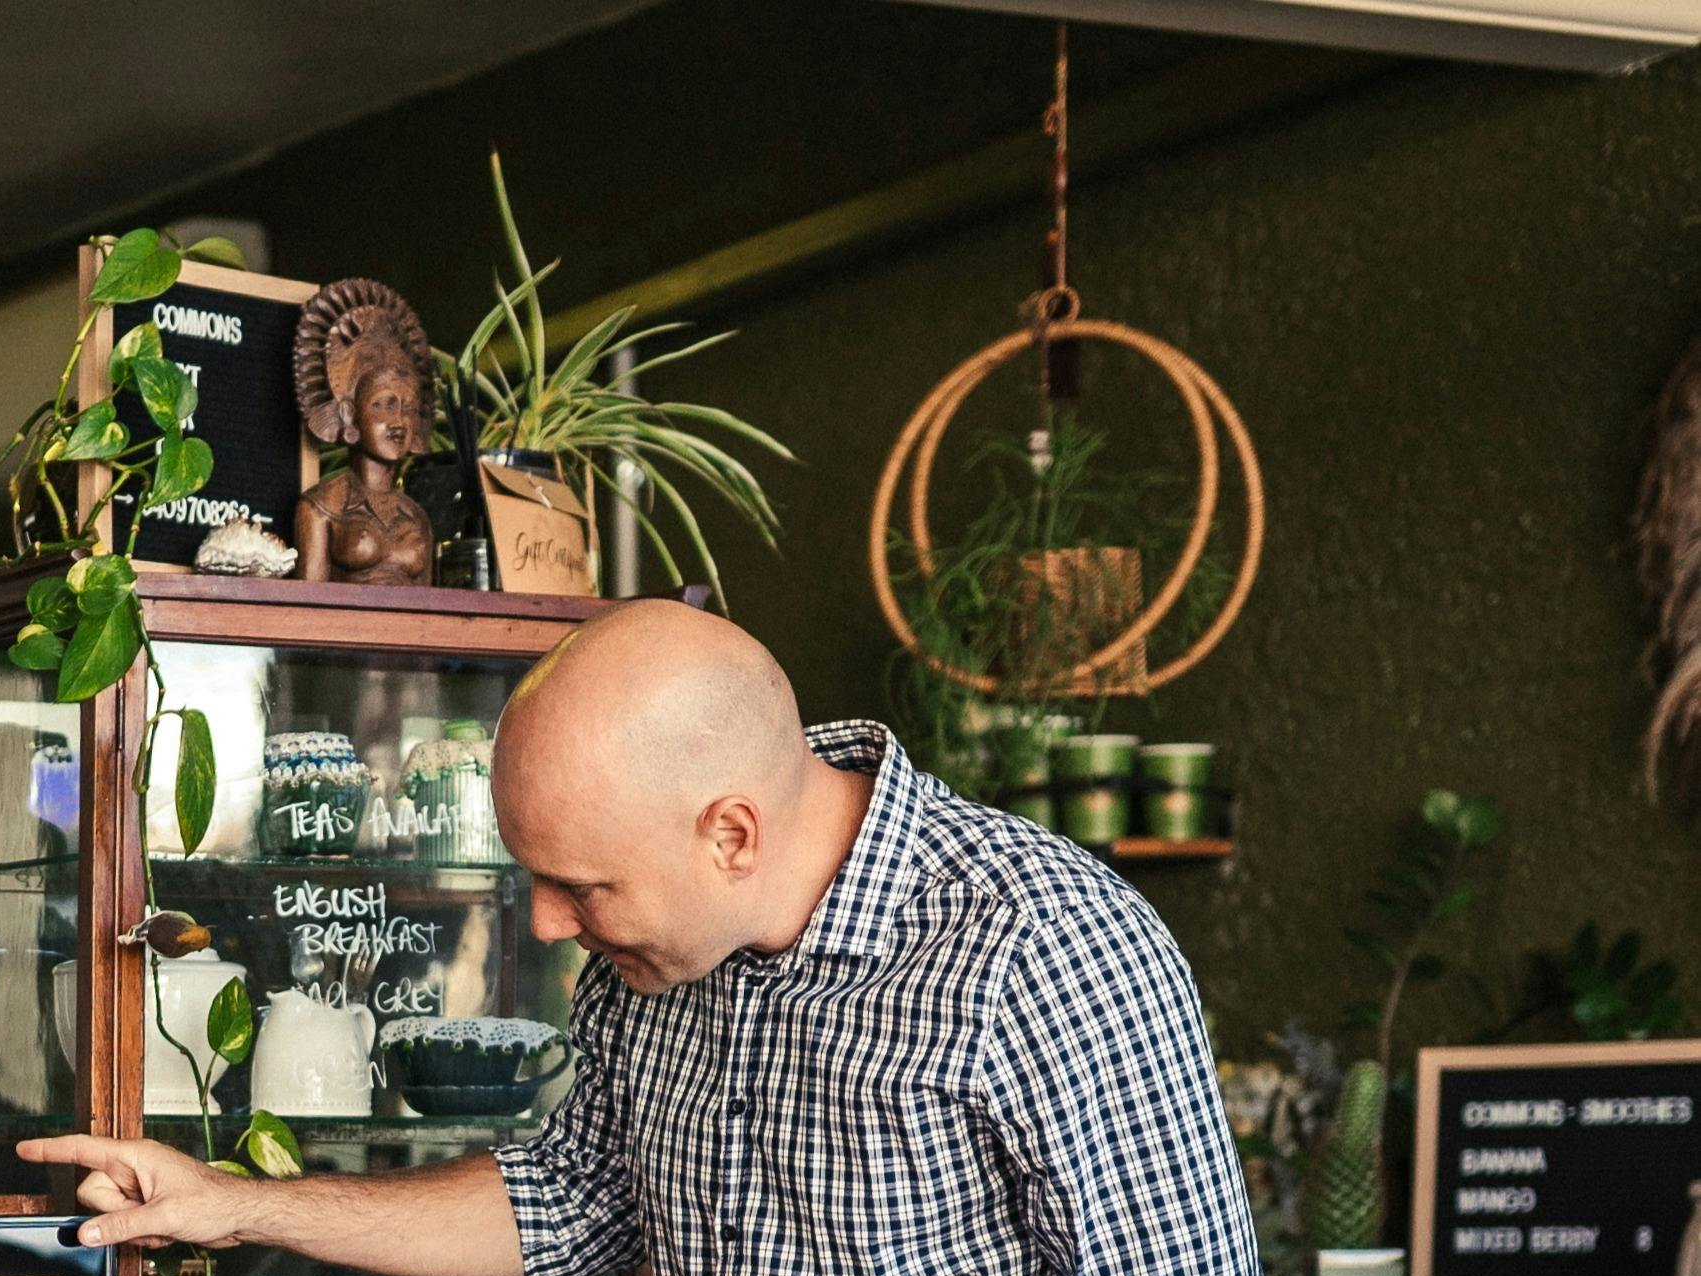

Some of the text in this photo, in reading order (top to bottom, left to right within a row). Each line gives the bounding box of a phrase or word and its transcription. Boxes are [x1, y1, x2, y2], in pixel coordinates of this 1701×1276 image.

[153, 303, 242, 344] COMMONS
[273, 801, 354, 841] TEAS
[273, 880, 387, 919] ENGLISH
[294, 916, 443, 956] BREAKFAST
[374, 976, 444, 1018] GREY
[1463, 1099, 1565, 1128] COMMONS
[1461, 1147, 1547, 1177] BANANA
[1456, 1186, 1537, 1214] MANGO
[1454, 1226, 1523, 1253] MIXED
[1529, 1226, 1599, 1253] BERRY
